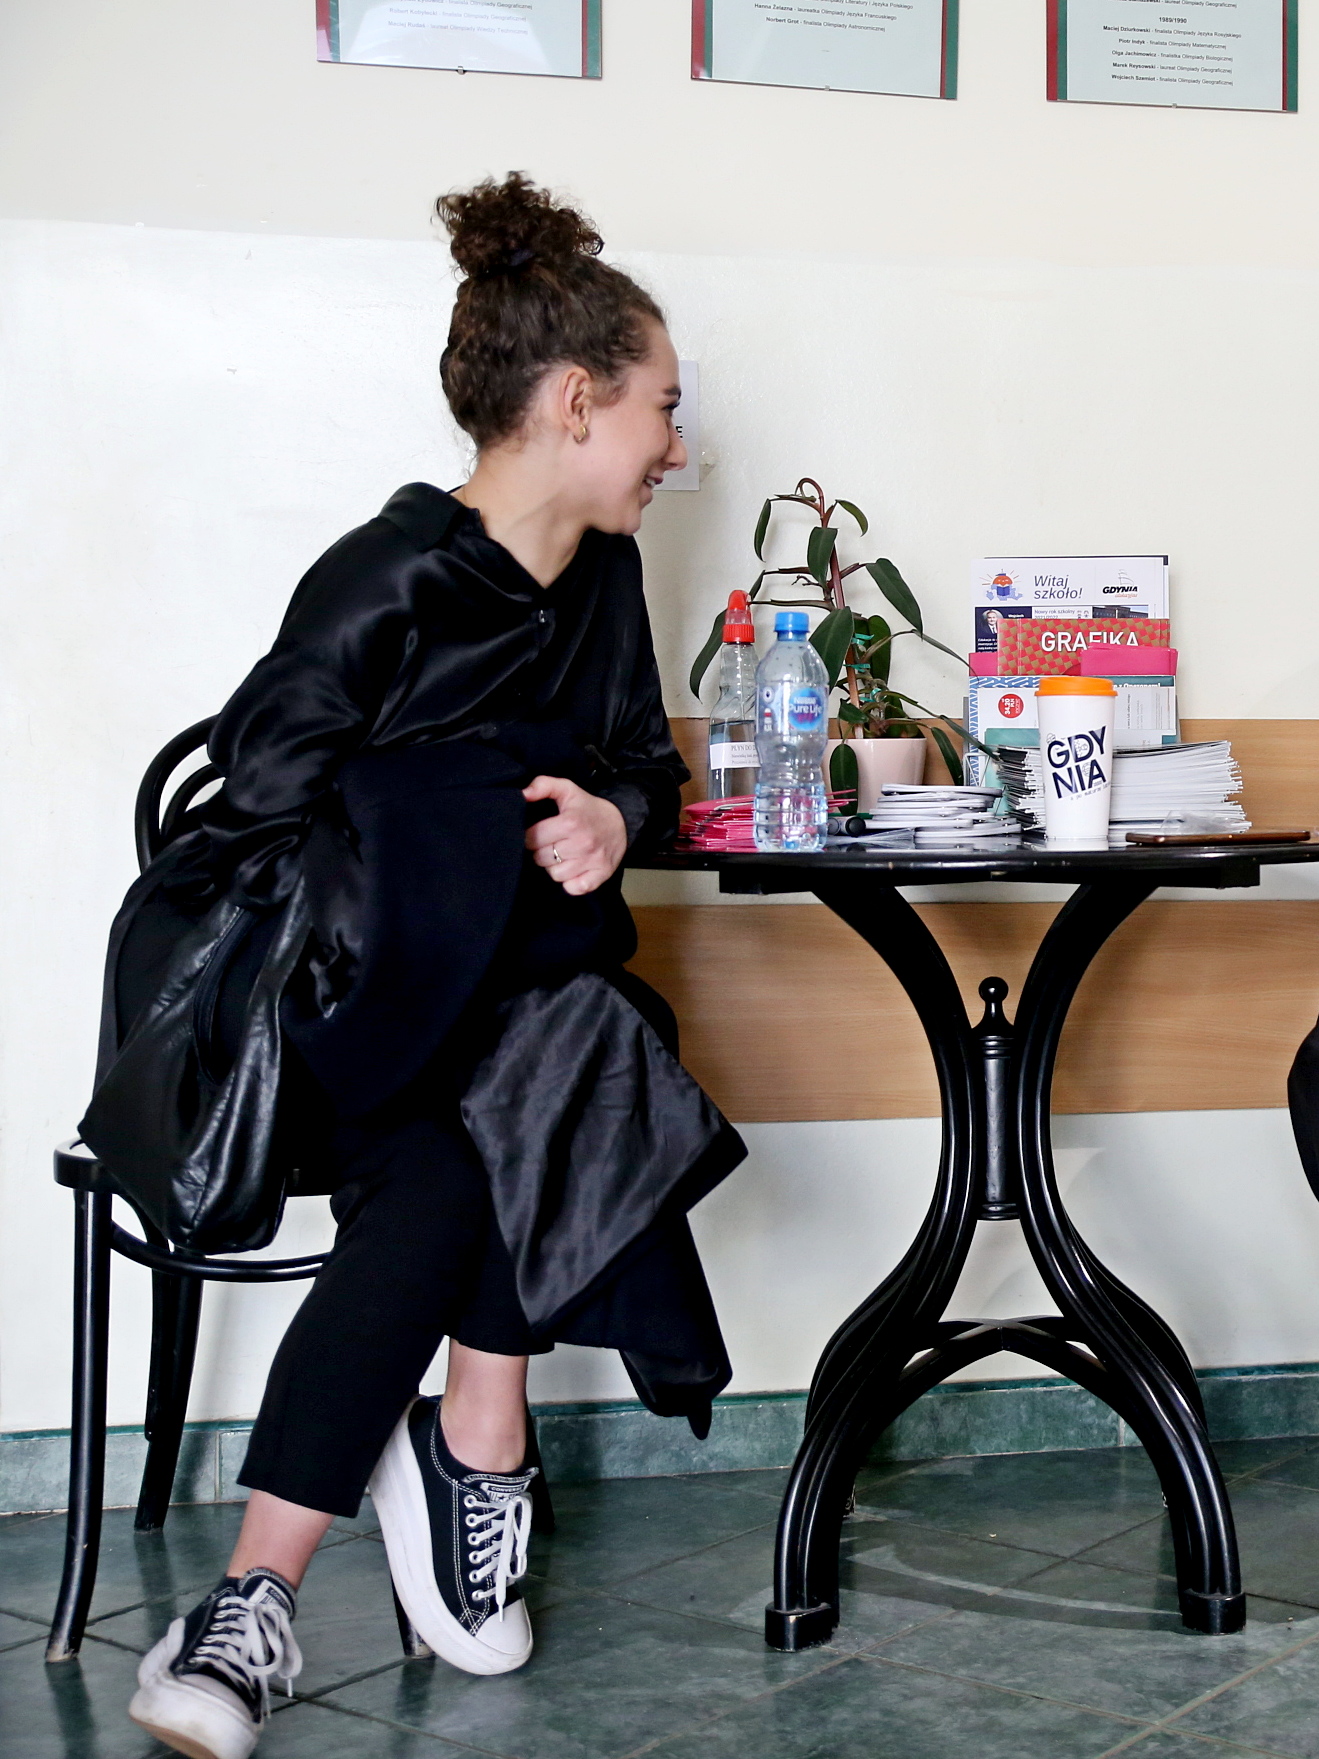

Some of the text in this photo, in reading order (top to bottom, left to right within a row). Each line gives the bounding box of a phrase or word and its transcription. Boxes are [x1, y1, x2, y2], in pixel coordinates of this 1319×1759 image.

[1034, 575, 1069, 588] Witaj
[1102, 586, 1138, 594] GDYNIA
[1034, 587, 1083, 600] szkoło!
[1041, 631, 1139, 652] GRAFIKA
[1047, 725, 1106, 768] GDY
[1052, 759, 1106, 799] NIA
